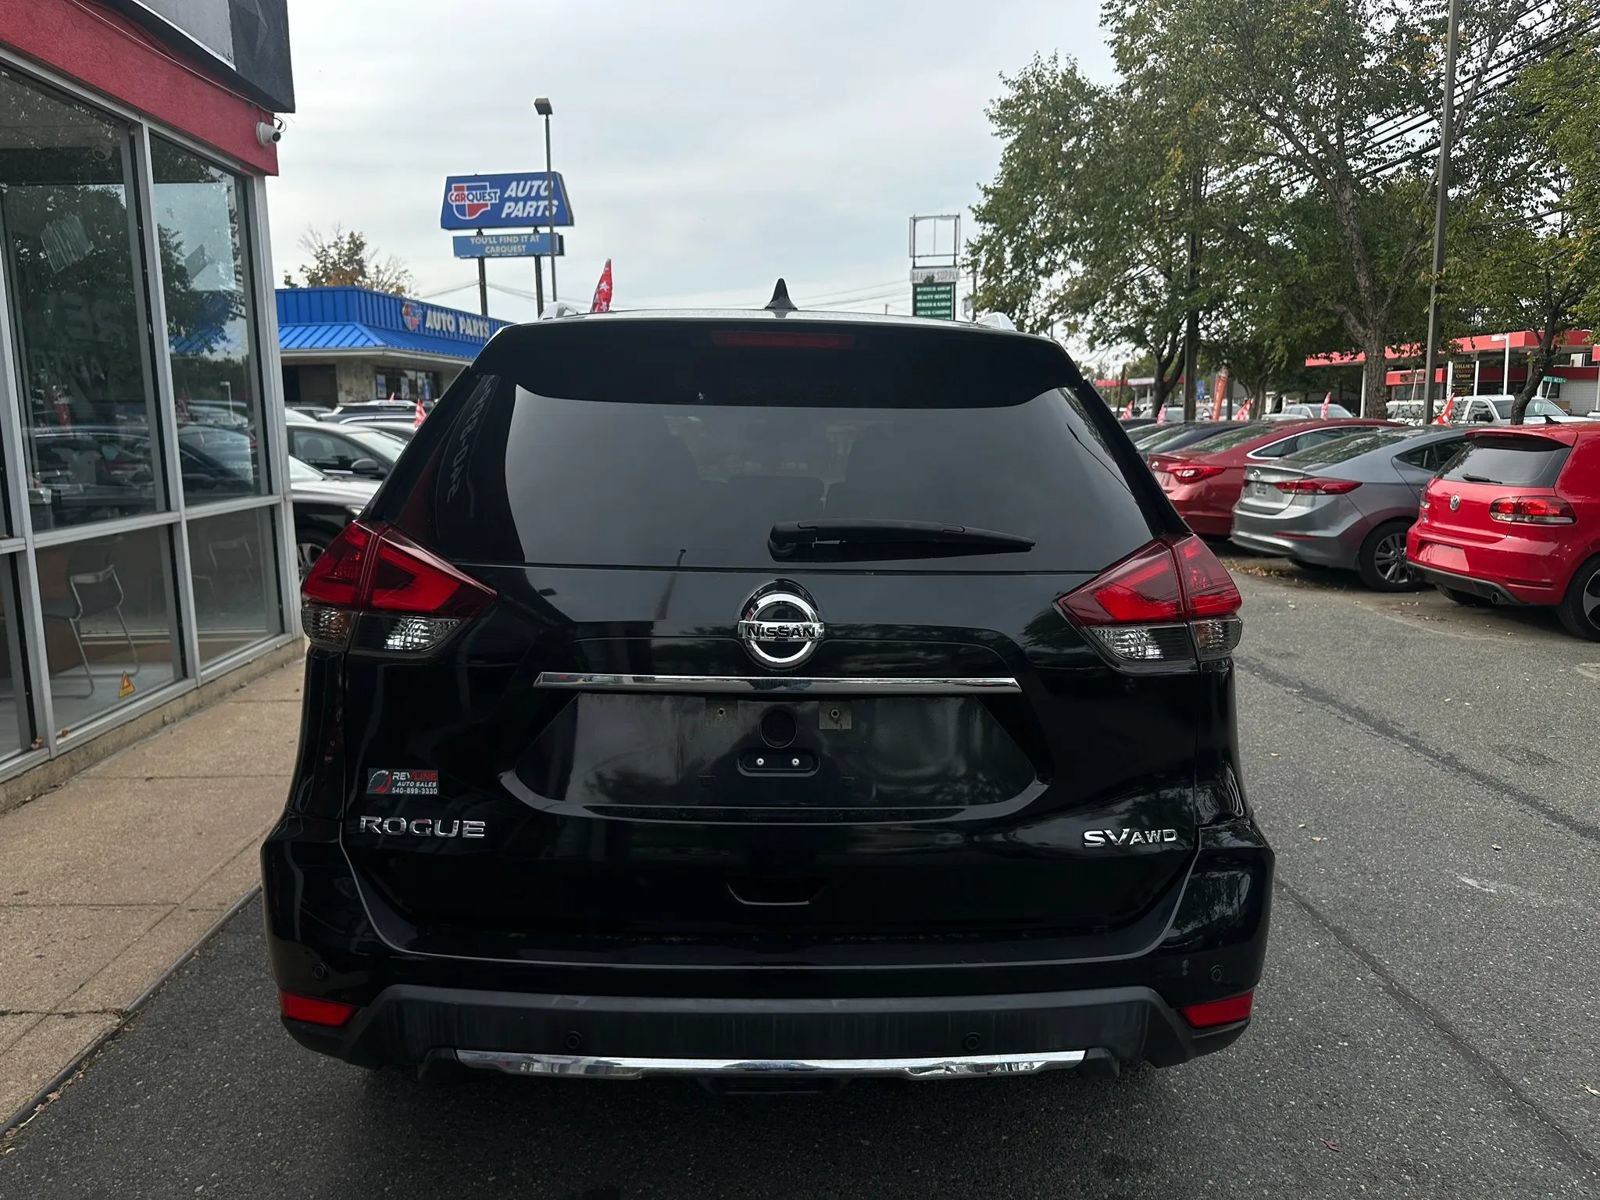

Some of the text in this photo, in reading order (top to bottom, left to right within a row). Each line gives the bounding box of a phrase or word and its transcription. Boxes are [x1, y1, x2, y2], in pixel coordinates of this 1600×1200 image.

[449, 190, 499, 204] CARQUEST
[504, 180, 554, 198] AUTO
[501, 200, 559, 218] PARTS
[470, 234, 540, 245] YOU'LL FIND IT AT
[485, 245, 526, 254] CARQUEST
[425, 310, 456, 333] AUTO
[459, 316, 490, 338] PARTS
[747, 626, 816, 638] NISSAN
[360, 815, 486, 839] ROGUE
